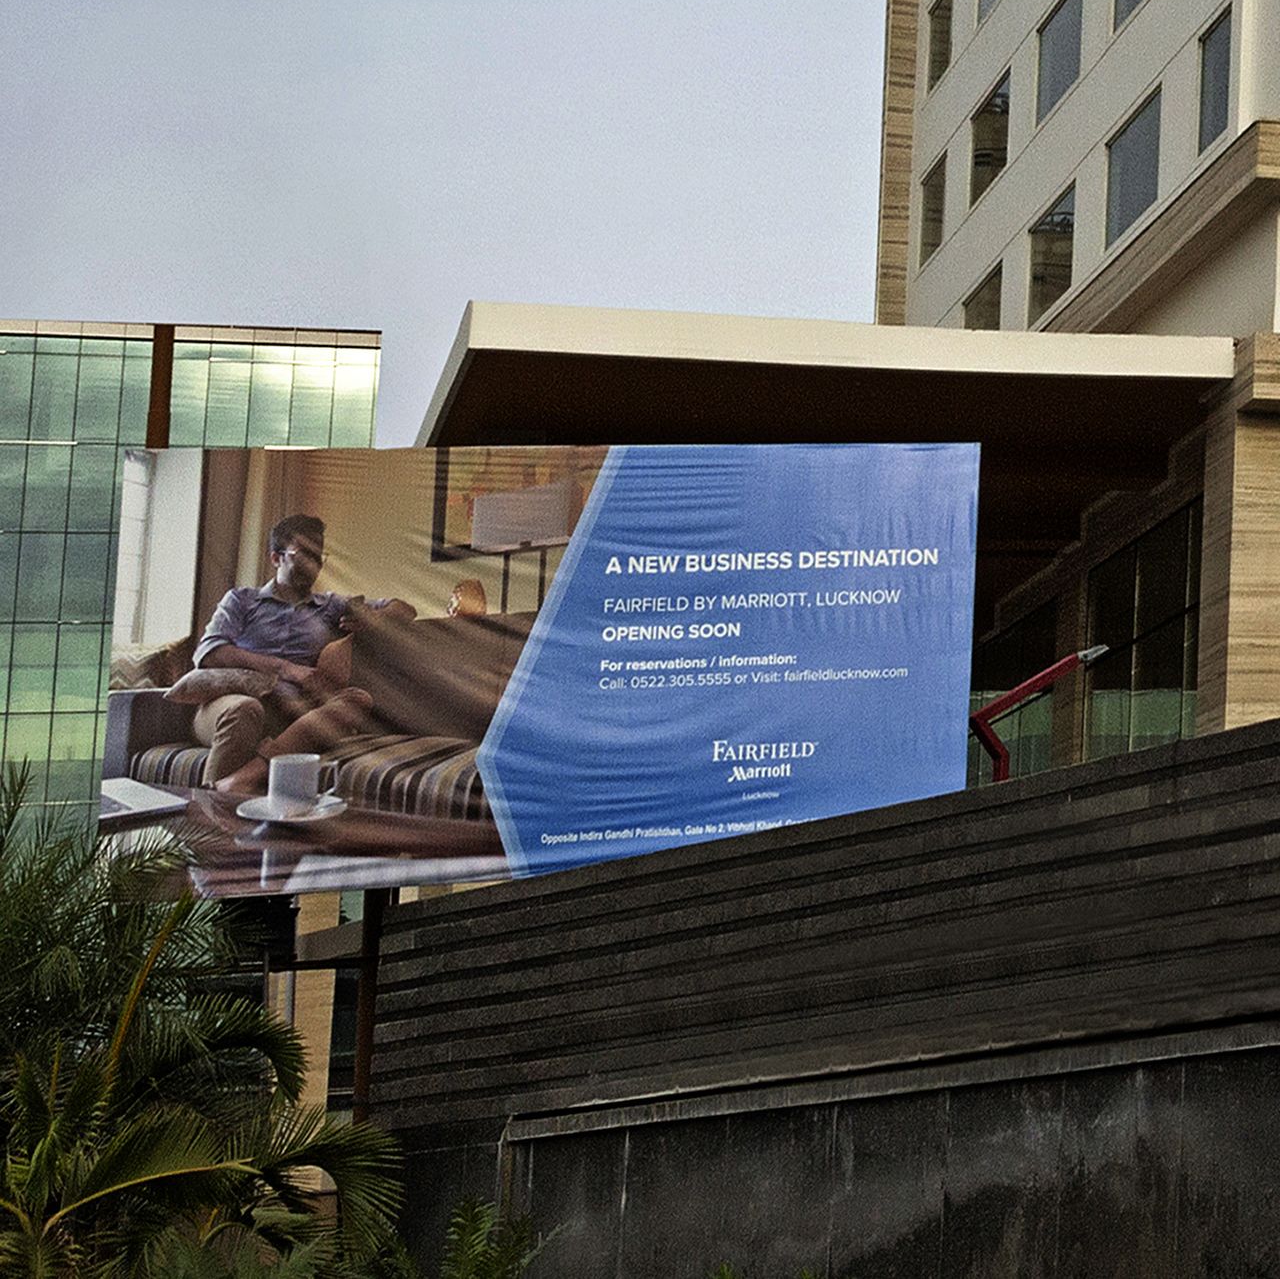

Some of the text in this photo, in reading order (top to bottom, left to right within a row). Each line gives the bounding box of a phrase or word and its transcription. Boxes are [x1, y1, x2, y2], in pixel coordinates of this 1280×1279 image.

[605, 548, 939, 574] A NEW BUSINESS DESTINATION
[604, 596, 689, 613] FAIRFIELD
[694, 595, 717, 611] BY
[816, 589, 901, 606] LUCKNOW
[602, 622, 741, 642] OPENING SOON
[600, 660, 623, 672] For
[626, 657, 707, 671] reservations
[599, 675, 627, 690] Call:
[734, 673, 747, 684] or
[751, 671, 781, 683] Visit:
[784, 667, 909, 682] fairfieldlucknow.com
[712, 740, 816, 762] FAIRFIELD
[727, 763, 791, 783] Marriott
[742, 791, 780, 801] Lucknow
